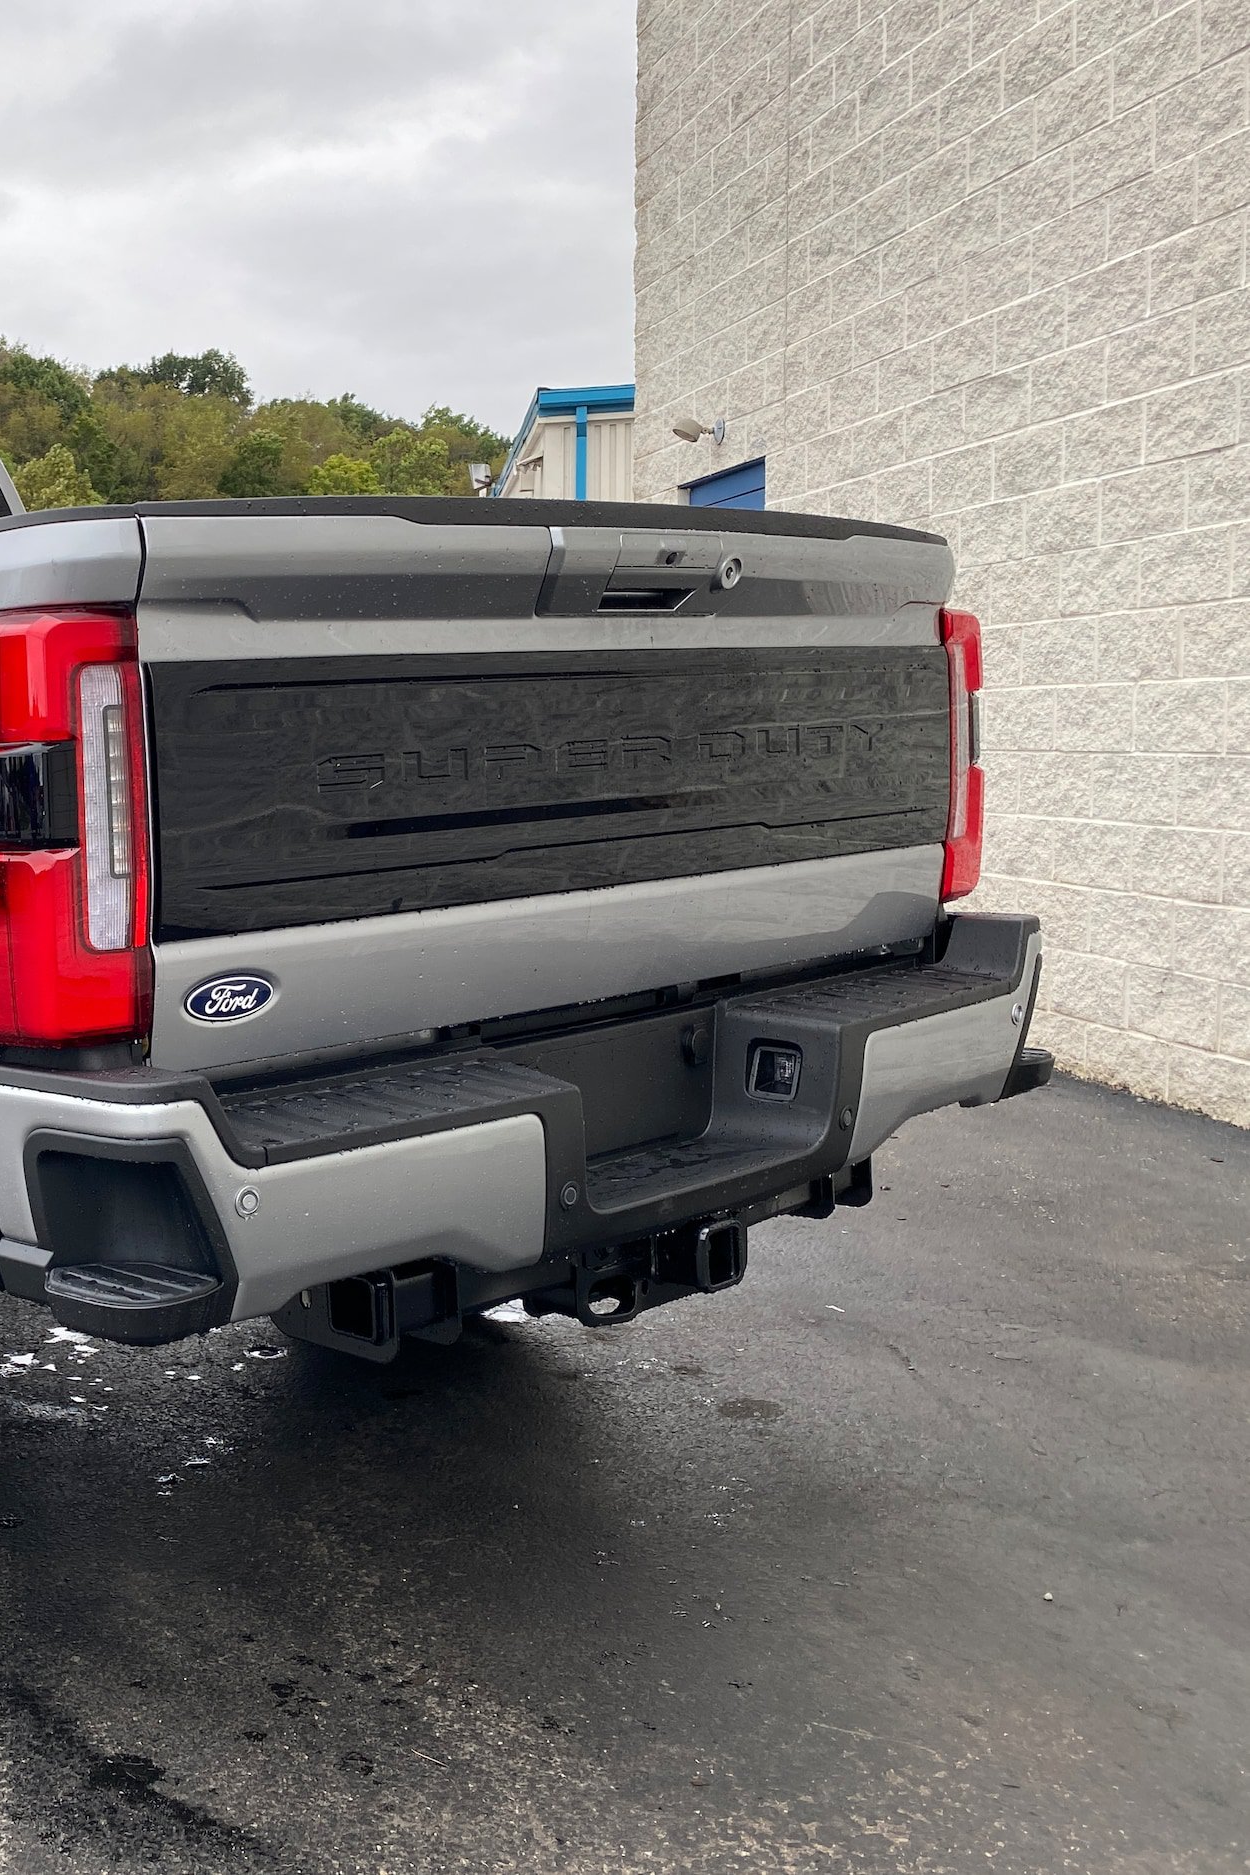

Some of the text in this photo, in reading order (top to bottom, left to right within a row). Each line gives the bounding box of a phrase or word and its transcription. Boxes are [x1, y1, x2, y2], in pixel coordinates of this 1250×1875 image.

[316, 723, 884, 793] SUPER DUTY
[204, 983, 260, 1015] Ford
